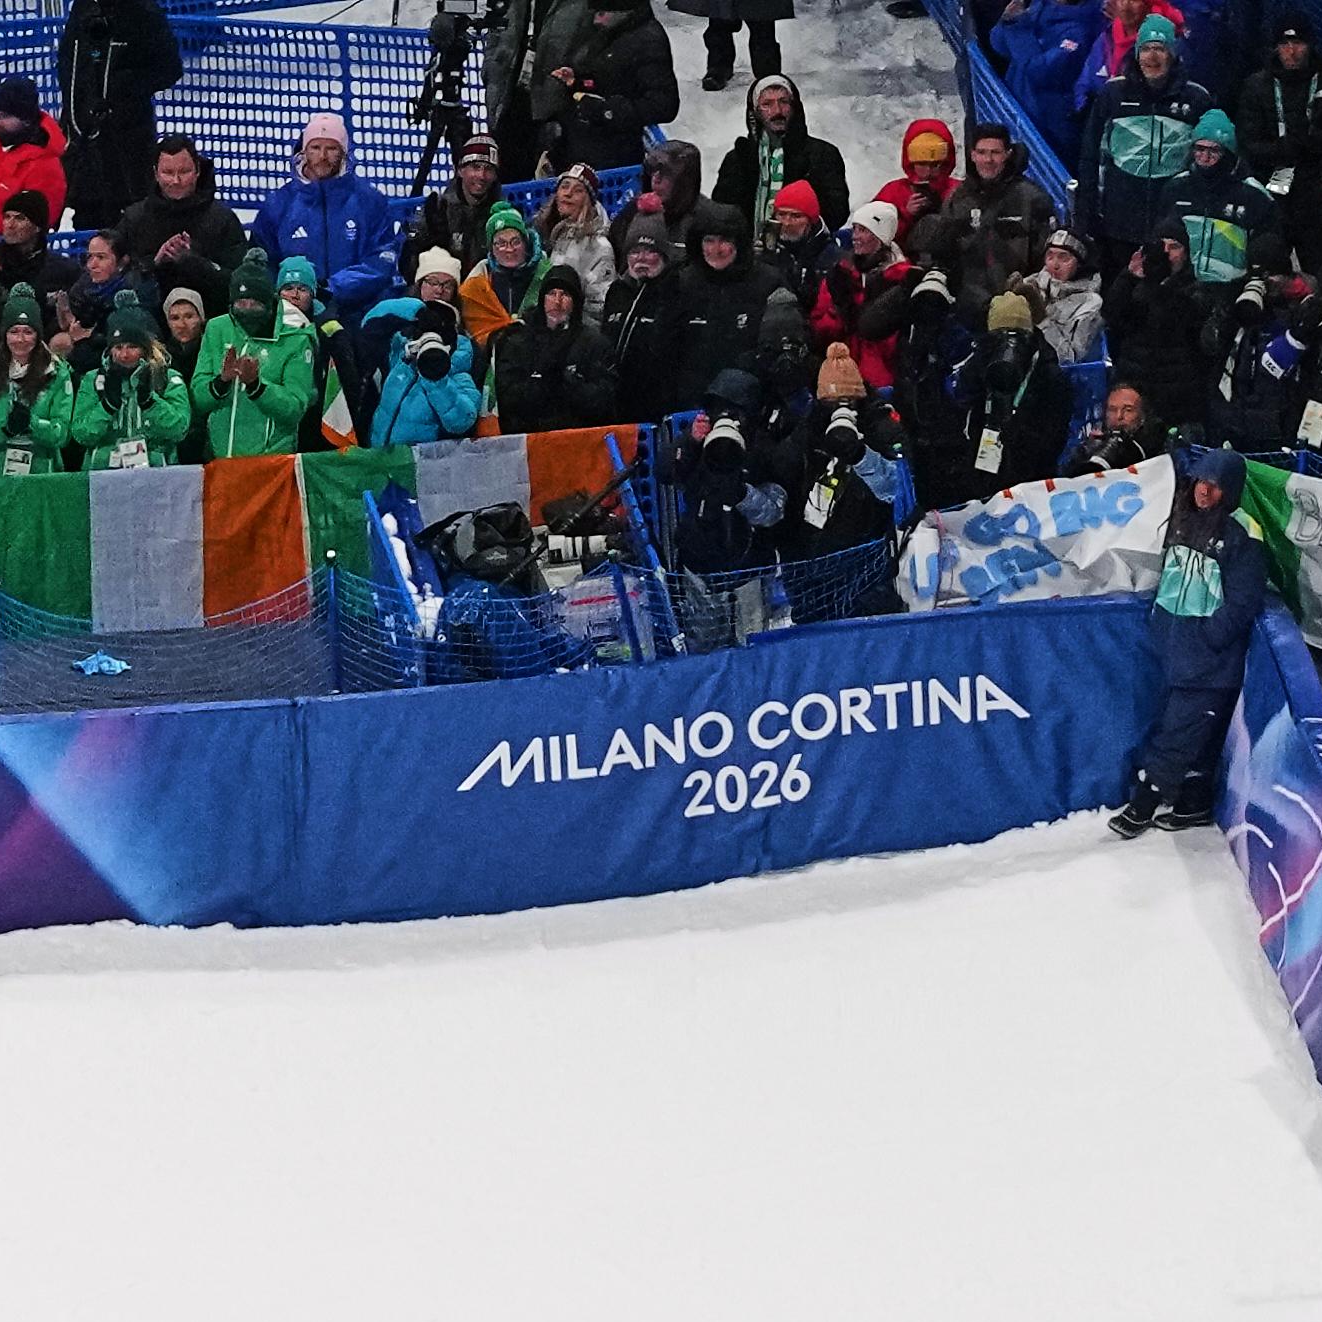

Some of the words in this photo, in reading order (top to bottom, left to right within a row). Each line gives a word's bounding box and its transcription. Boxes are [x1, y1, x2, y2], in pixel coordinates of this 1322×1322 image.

[963, 503, 1041, 545] GO
[457, 711, 733, 791] MILANO
[747, 674, 1031, 750] CORTINA
[683, 753, 811, 818] 2026
